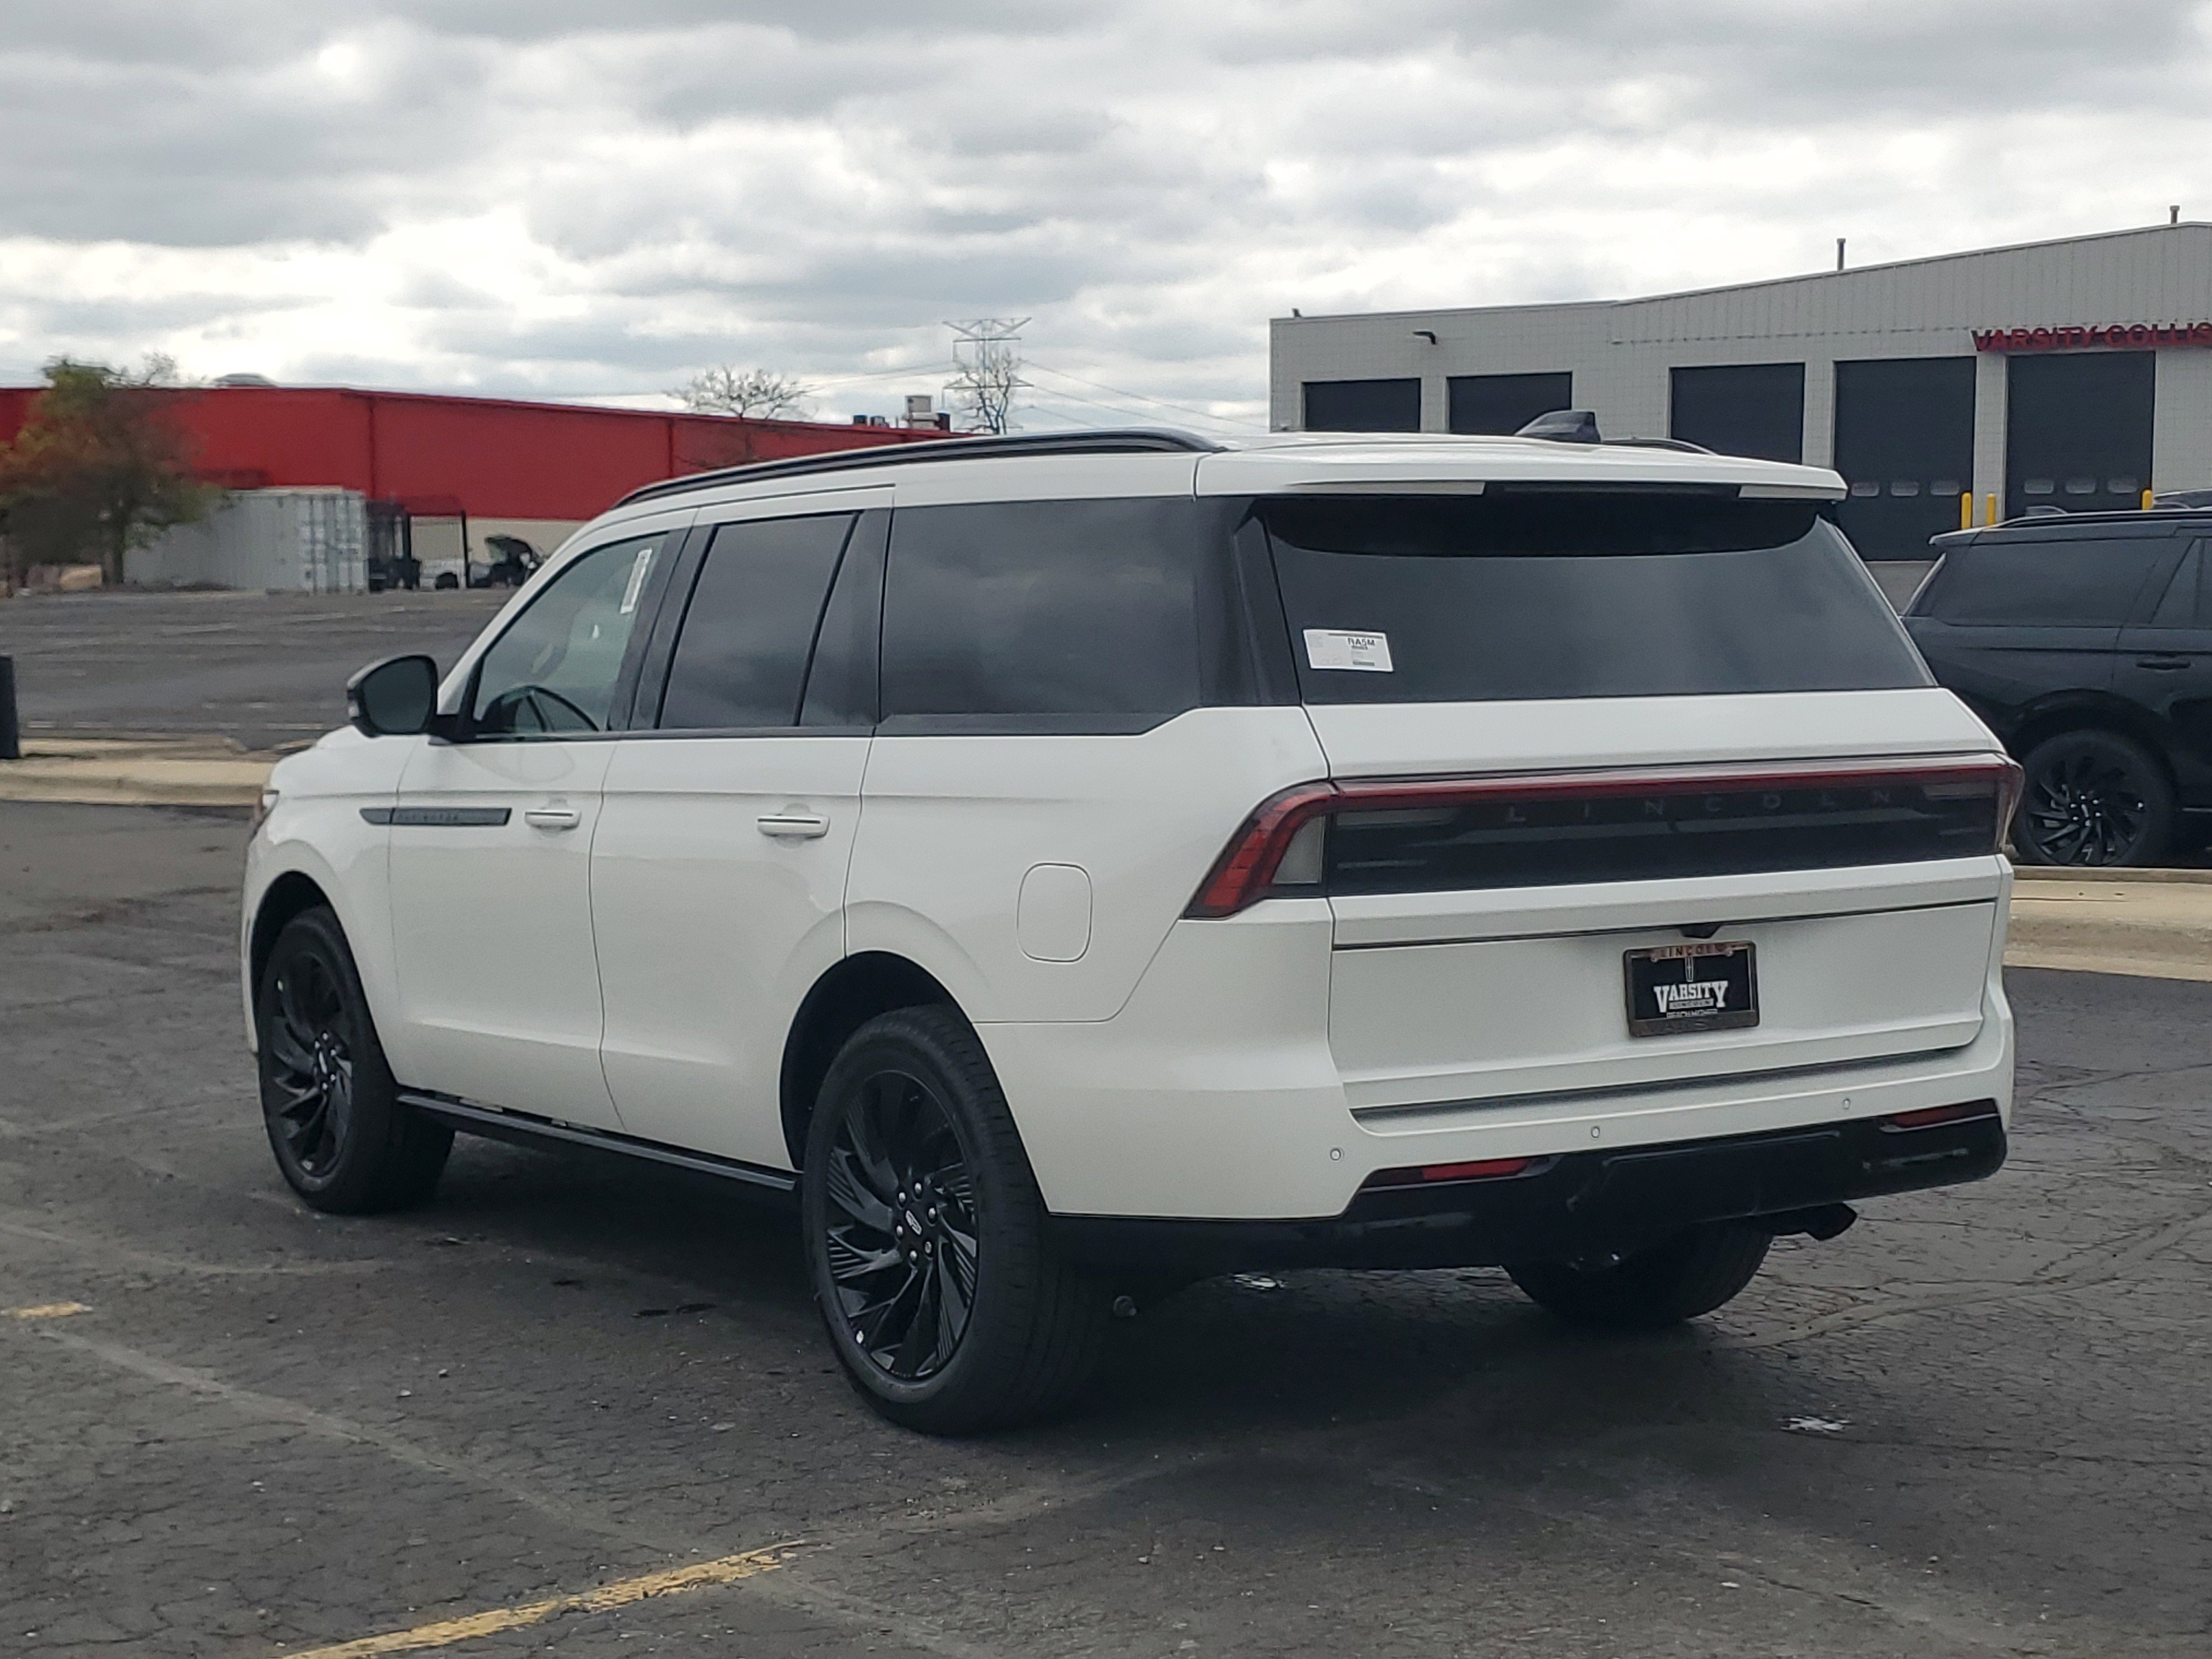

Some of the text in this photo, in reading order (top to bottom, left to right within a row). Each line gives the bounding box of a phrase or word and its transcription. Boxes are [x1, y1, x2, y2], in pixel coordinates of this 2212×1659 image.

[1971, 325, 2097, 351] VARSITY
[1505, 789, 1891, 822] LINCOLN
[1654, 980, 1728, 1013] VARSITY
